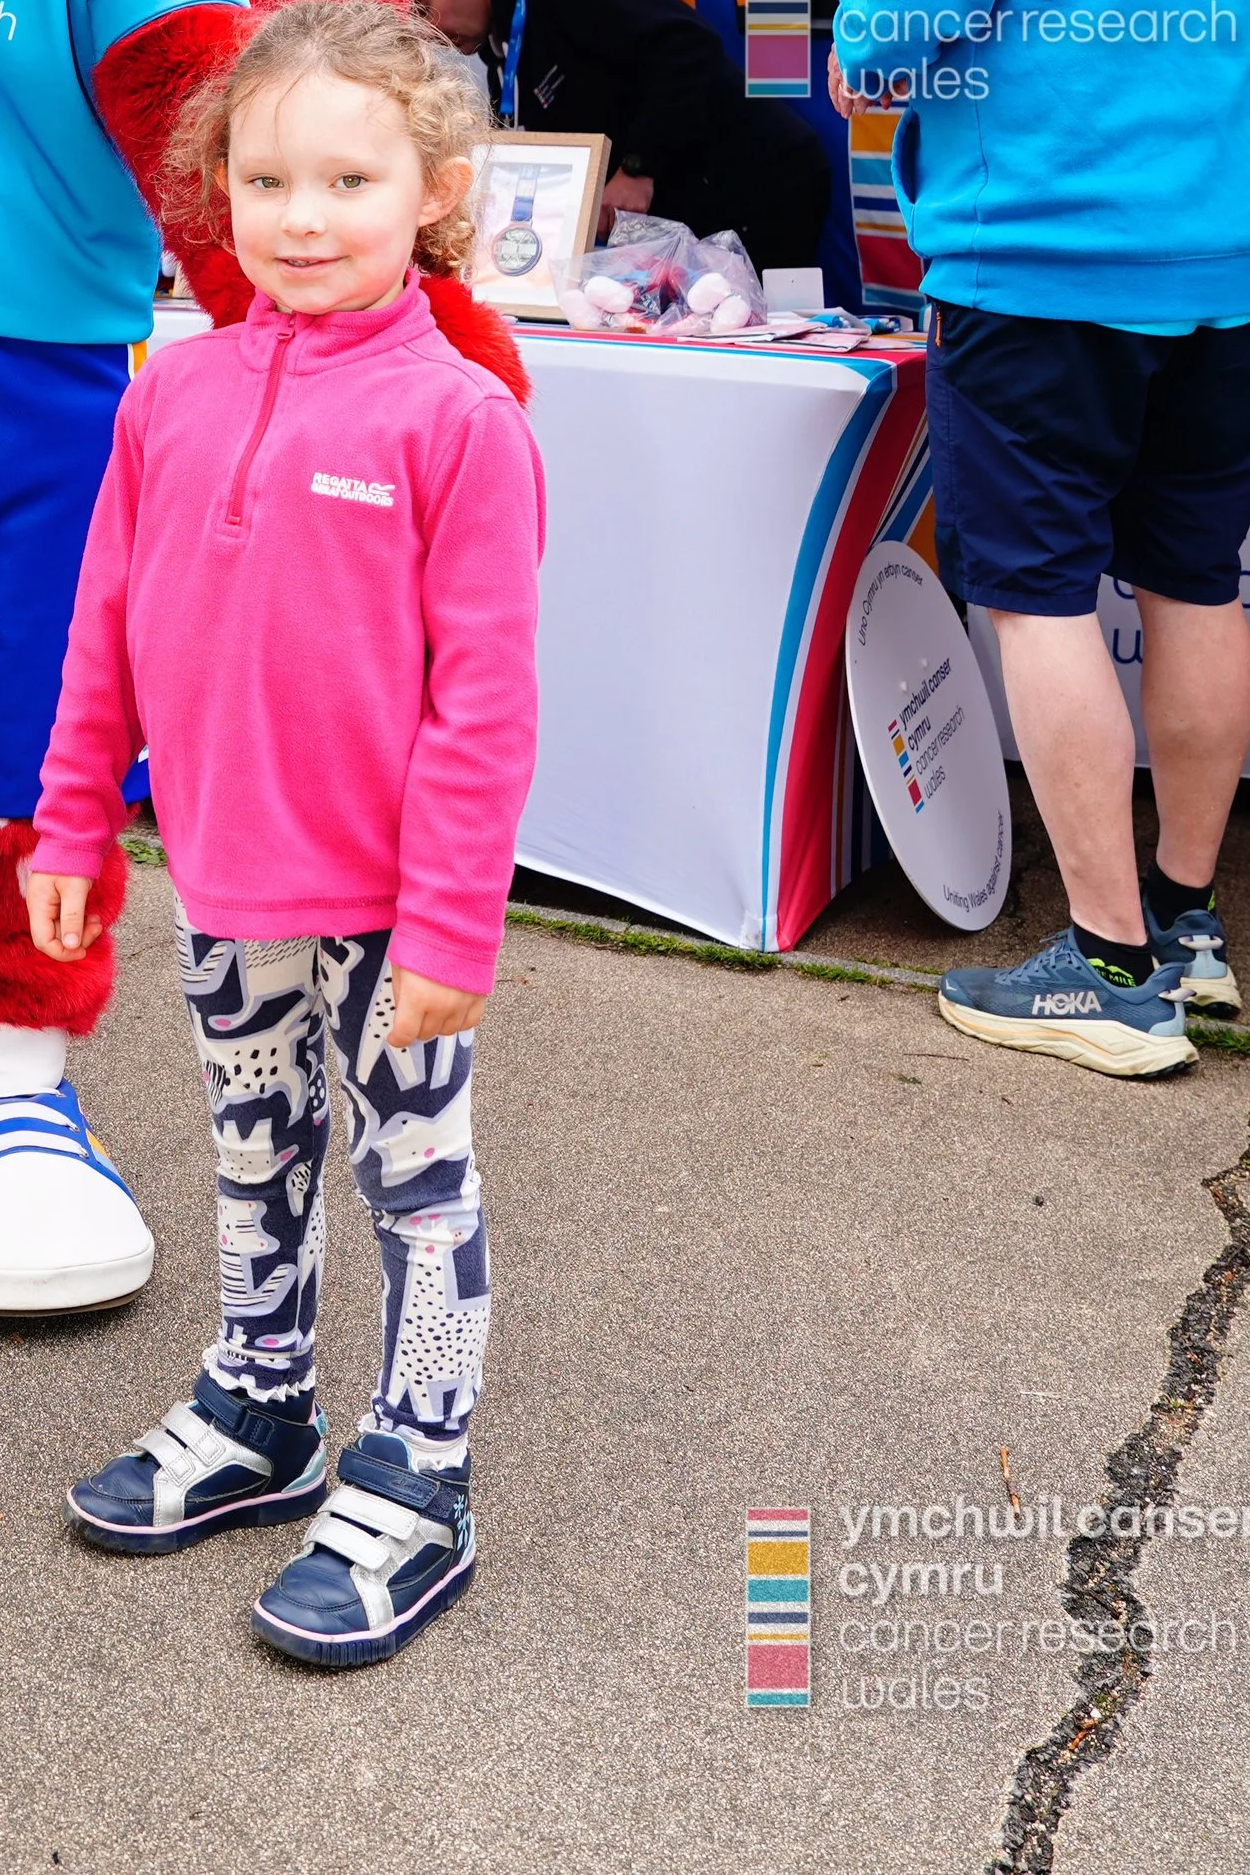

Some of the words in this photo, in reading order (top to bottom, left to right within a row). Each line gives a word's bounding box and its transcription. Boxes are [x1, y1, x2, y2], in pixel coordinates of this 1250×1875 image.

[312, 472, 368, 494] REGATTA
[340, 488, 394, 507] OUTDOORS
[862, 582, 879, 615] Cymru
[901, 564, 924, 587] canser
[899, 679, 931, 731] ymchwil
[928, 657, 952, 693] canser
[907, 715, 932, 751] cymru
[915, 742, 940, 775] cancer
[937, 705, 966, 749] research
[923, 765, 946, 799] wales
[943, 884, 970, 913] Uniting
[969, 888, 988, 908] Wales
[1031, 990, 1103, 1015] HOKA
